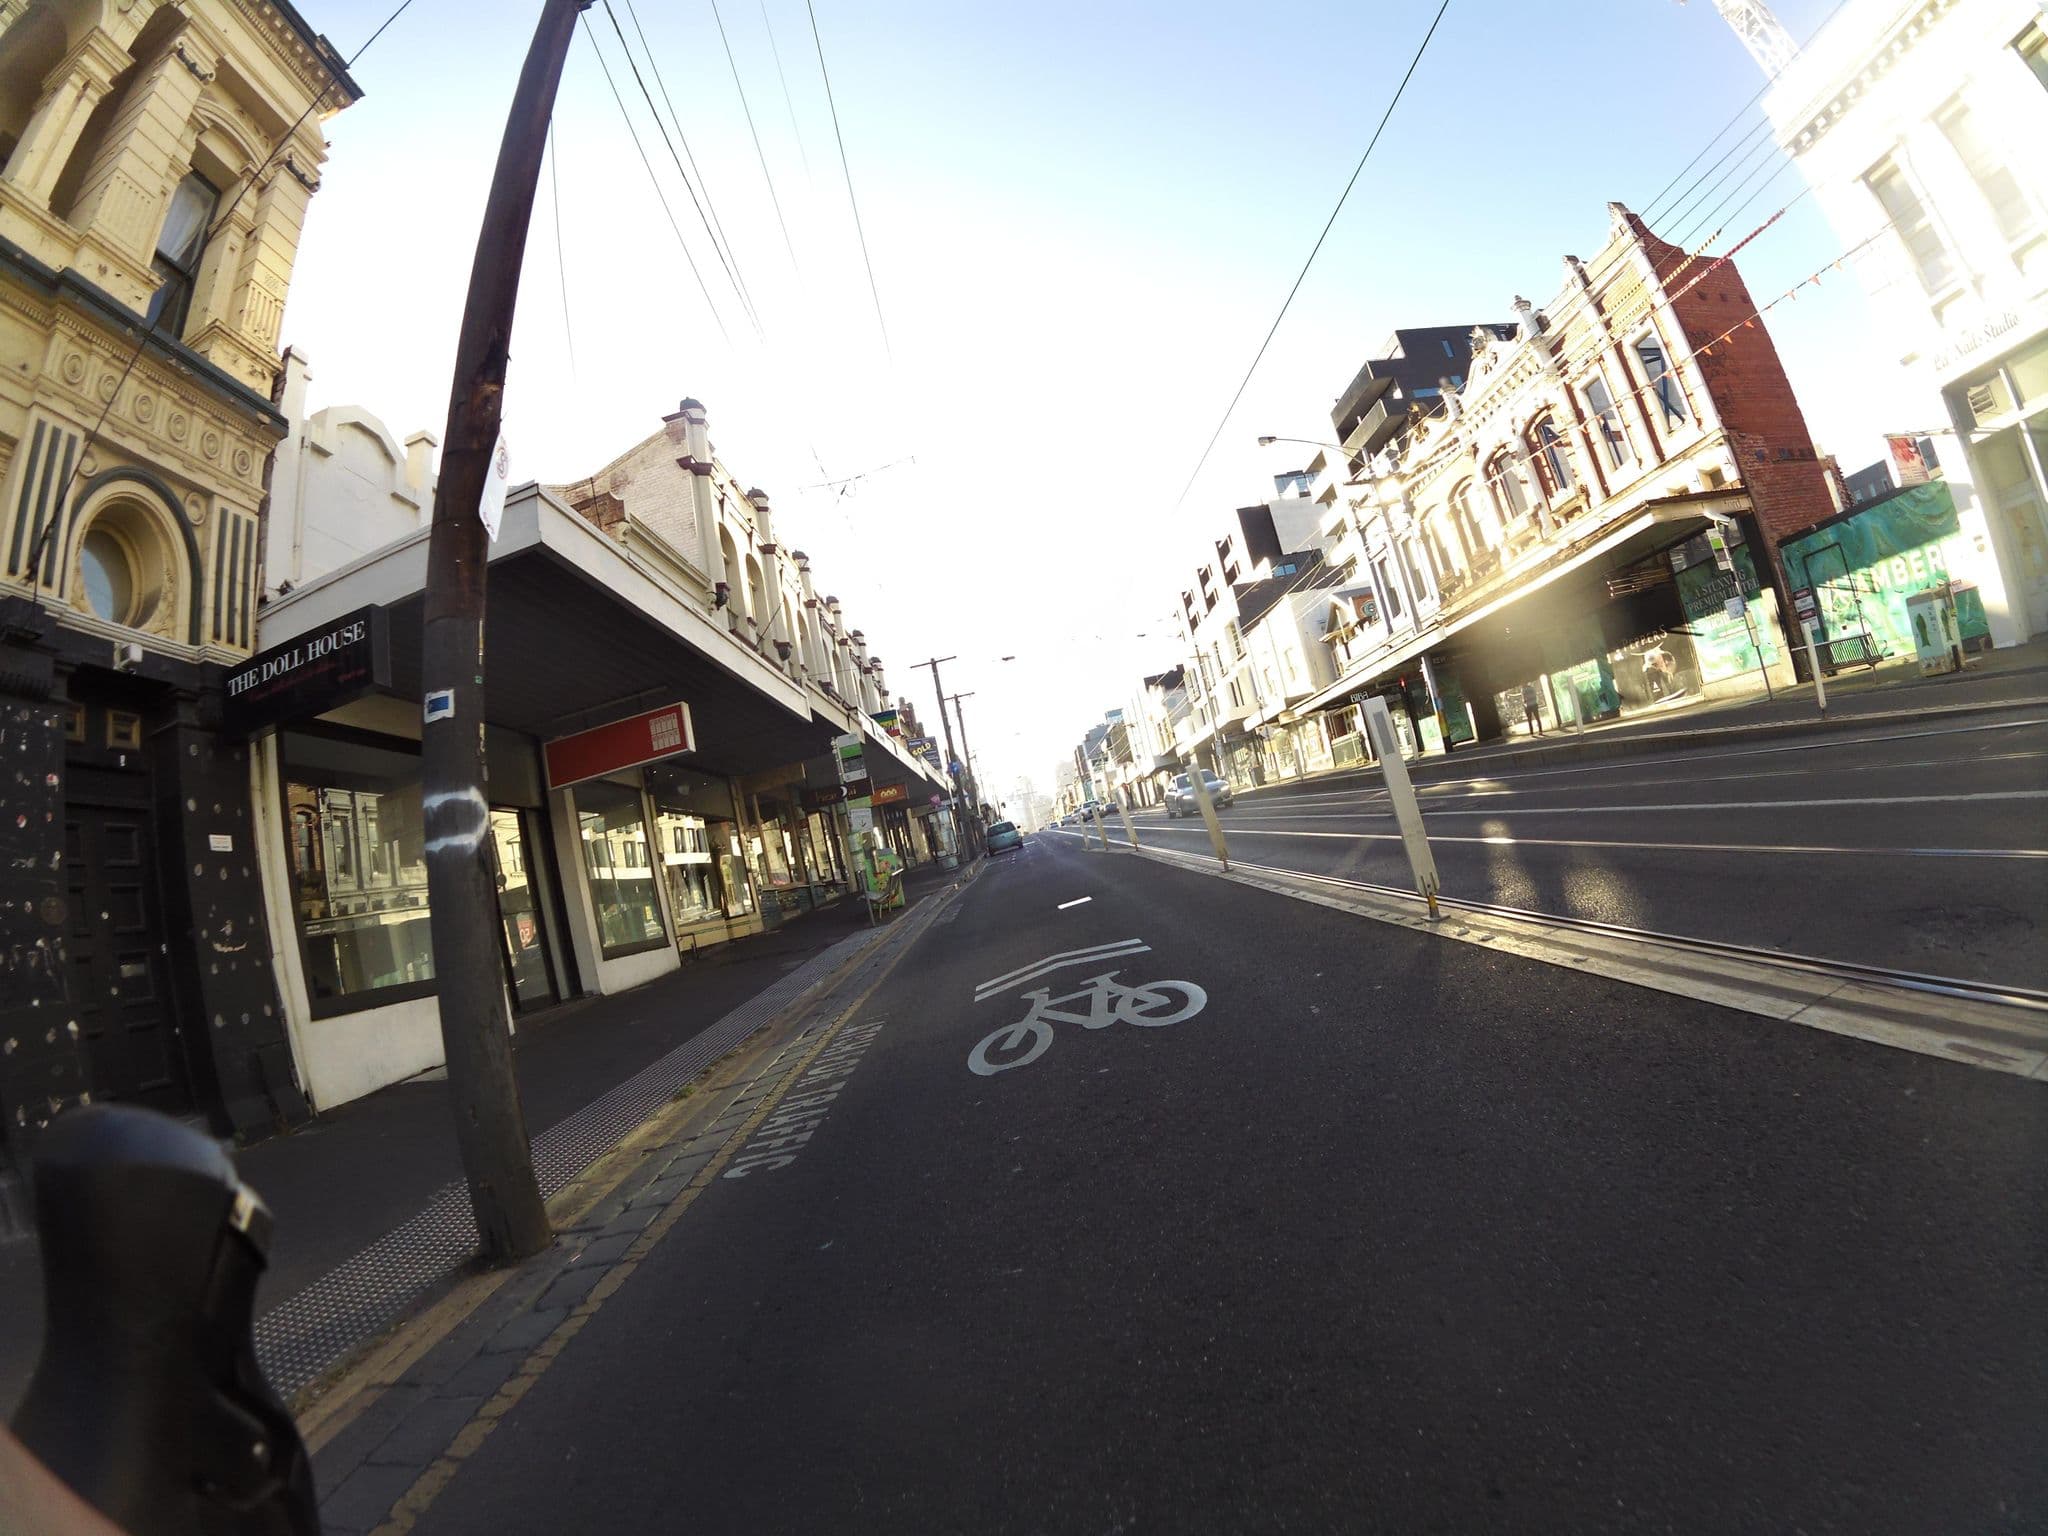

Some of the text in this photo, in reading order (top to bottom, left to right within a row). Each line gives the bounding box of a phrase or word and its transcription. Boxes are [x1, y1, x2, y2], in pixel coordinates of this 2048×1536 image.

[228, 668, 259, 697] THE
[262, 649, 304, 682] DOLL
[307, 620, 365, 661] HOUSE
[912, 742, 931, 756] SOLD
